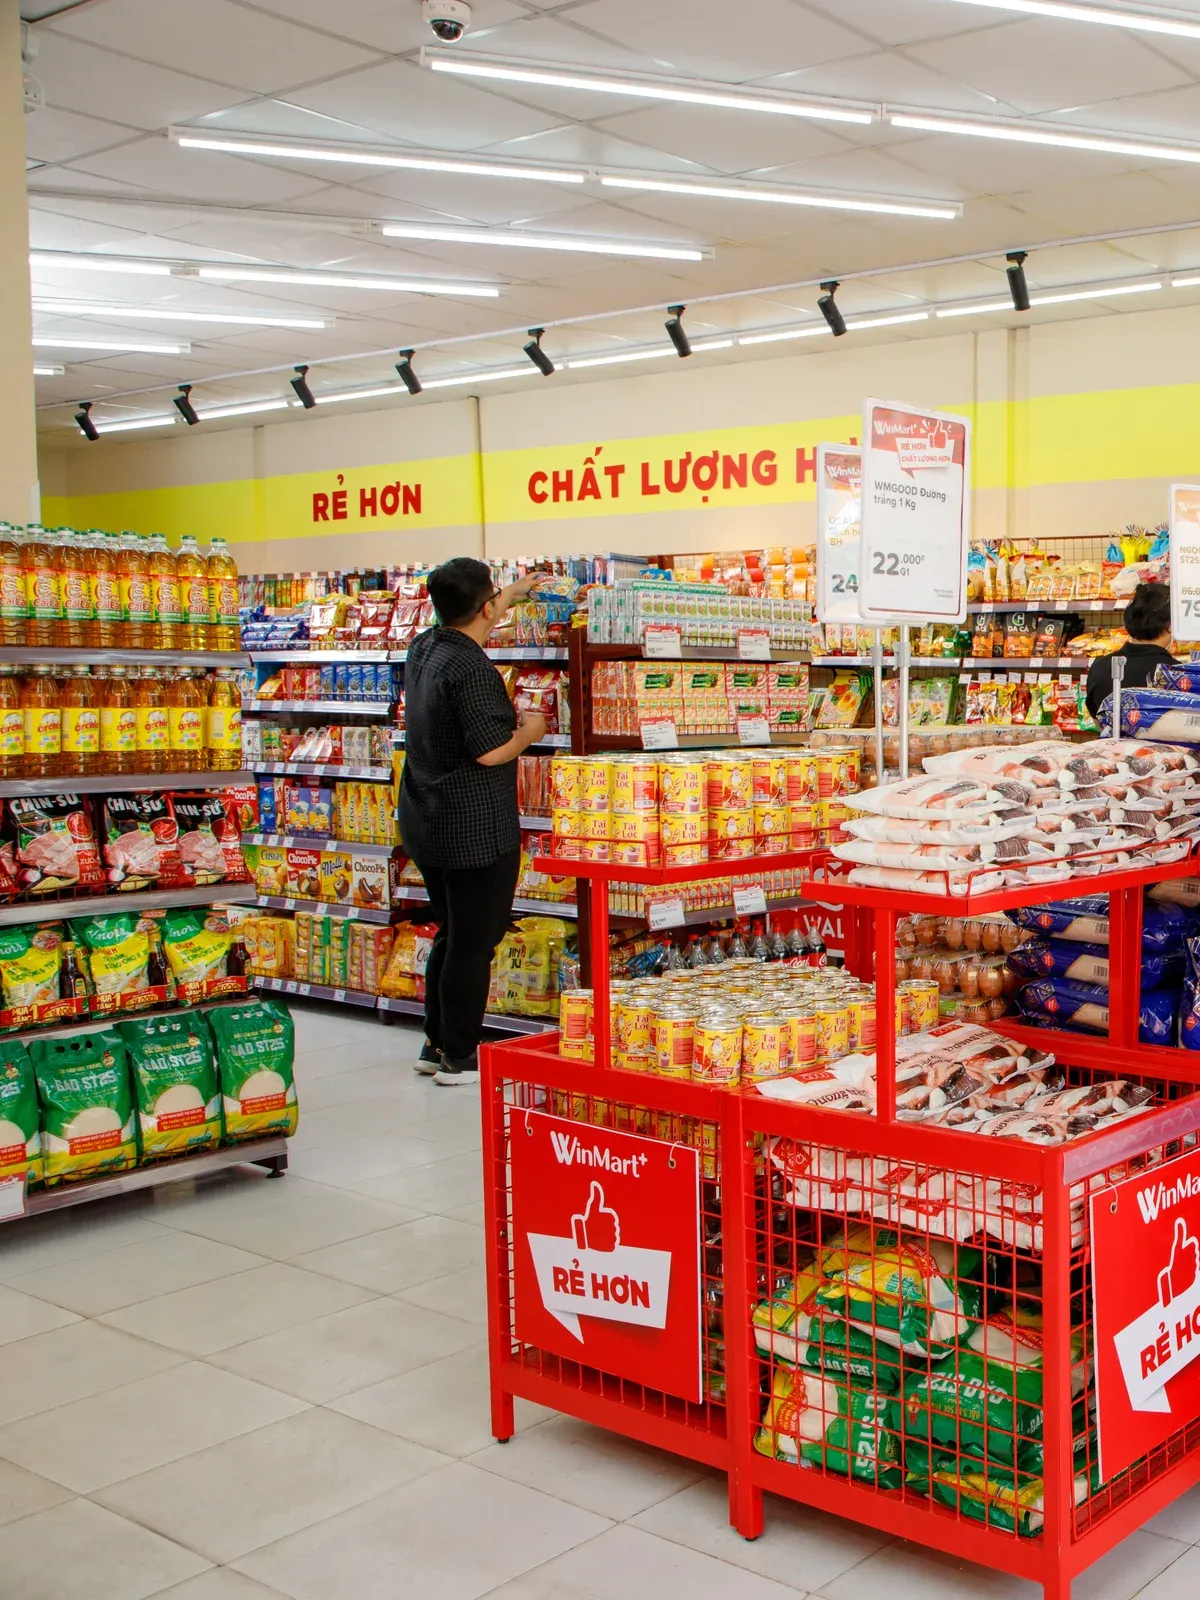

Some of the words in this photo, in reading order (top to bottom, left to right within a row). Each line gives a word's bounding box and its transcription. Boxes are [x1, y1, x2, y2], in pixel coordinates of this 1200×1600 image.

[528, 447, 625, 504] CHẤT
[641, 448, 778, 503] LƯỢNG
[874, 480, 918, 496] WMGOOD
[313, 474, 348, 522] RẺ
[359, 481, 422, 518] HƠN
[899, 498, 904, 507] 1
[905, 497, 916, 510] Kg
[872, 551, 899, 576] 22
[1179, 556, 1200, 565] ST25
[9, 793, 80, 814] CHIN-SU
[107, 797, 164, 813] CHIN-SU
[173, 799, 222, 816] HIN-SU
[803, 914, 845, 939] WAL
[550, 1130, 648, 1178] WinMart+
[552, 1258, 585, 1296] RẺ
[590, 1273, 650, 1308] HƠN
[1139, 1321, 1171, 1380] RẺ
